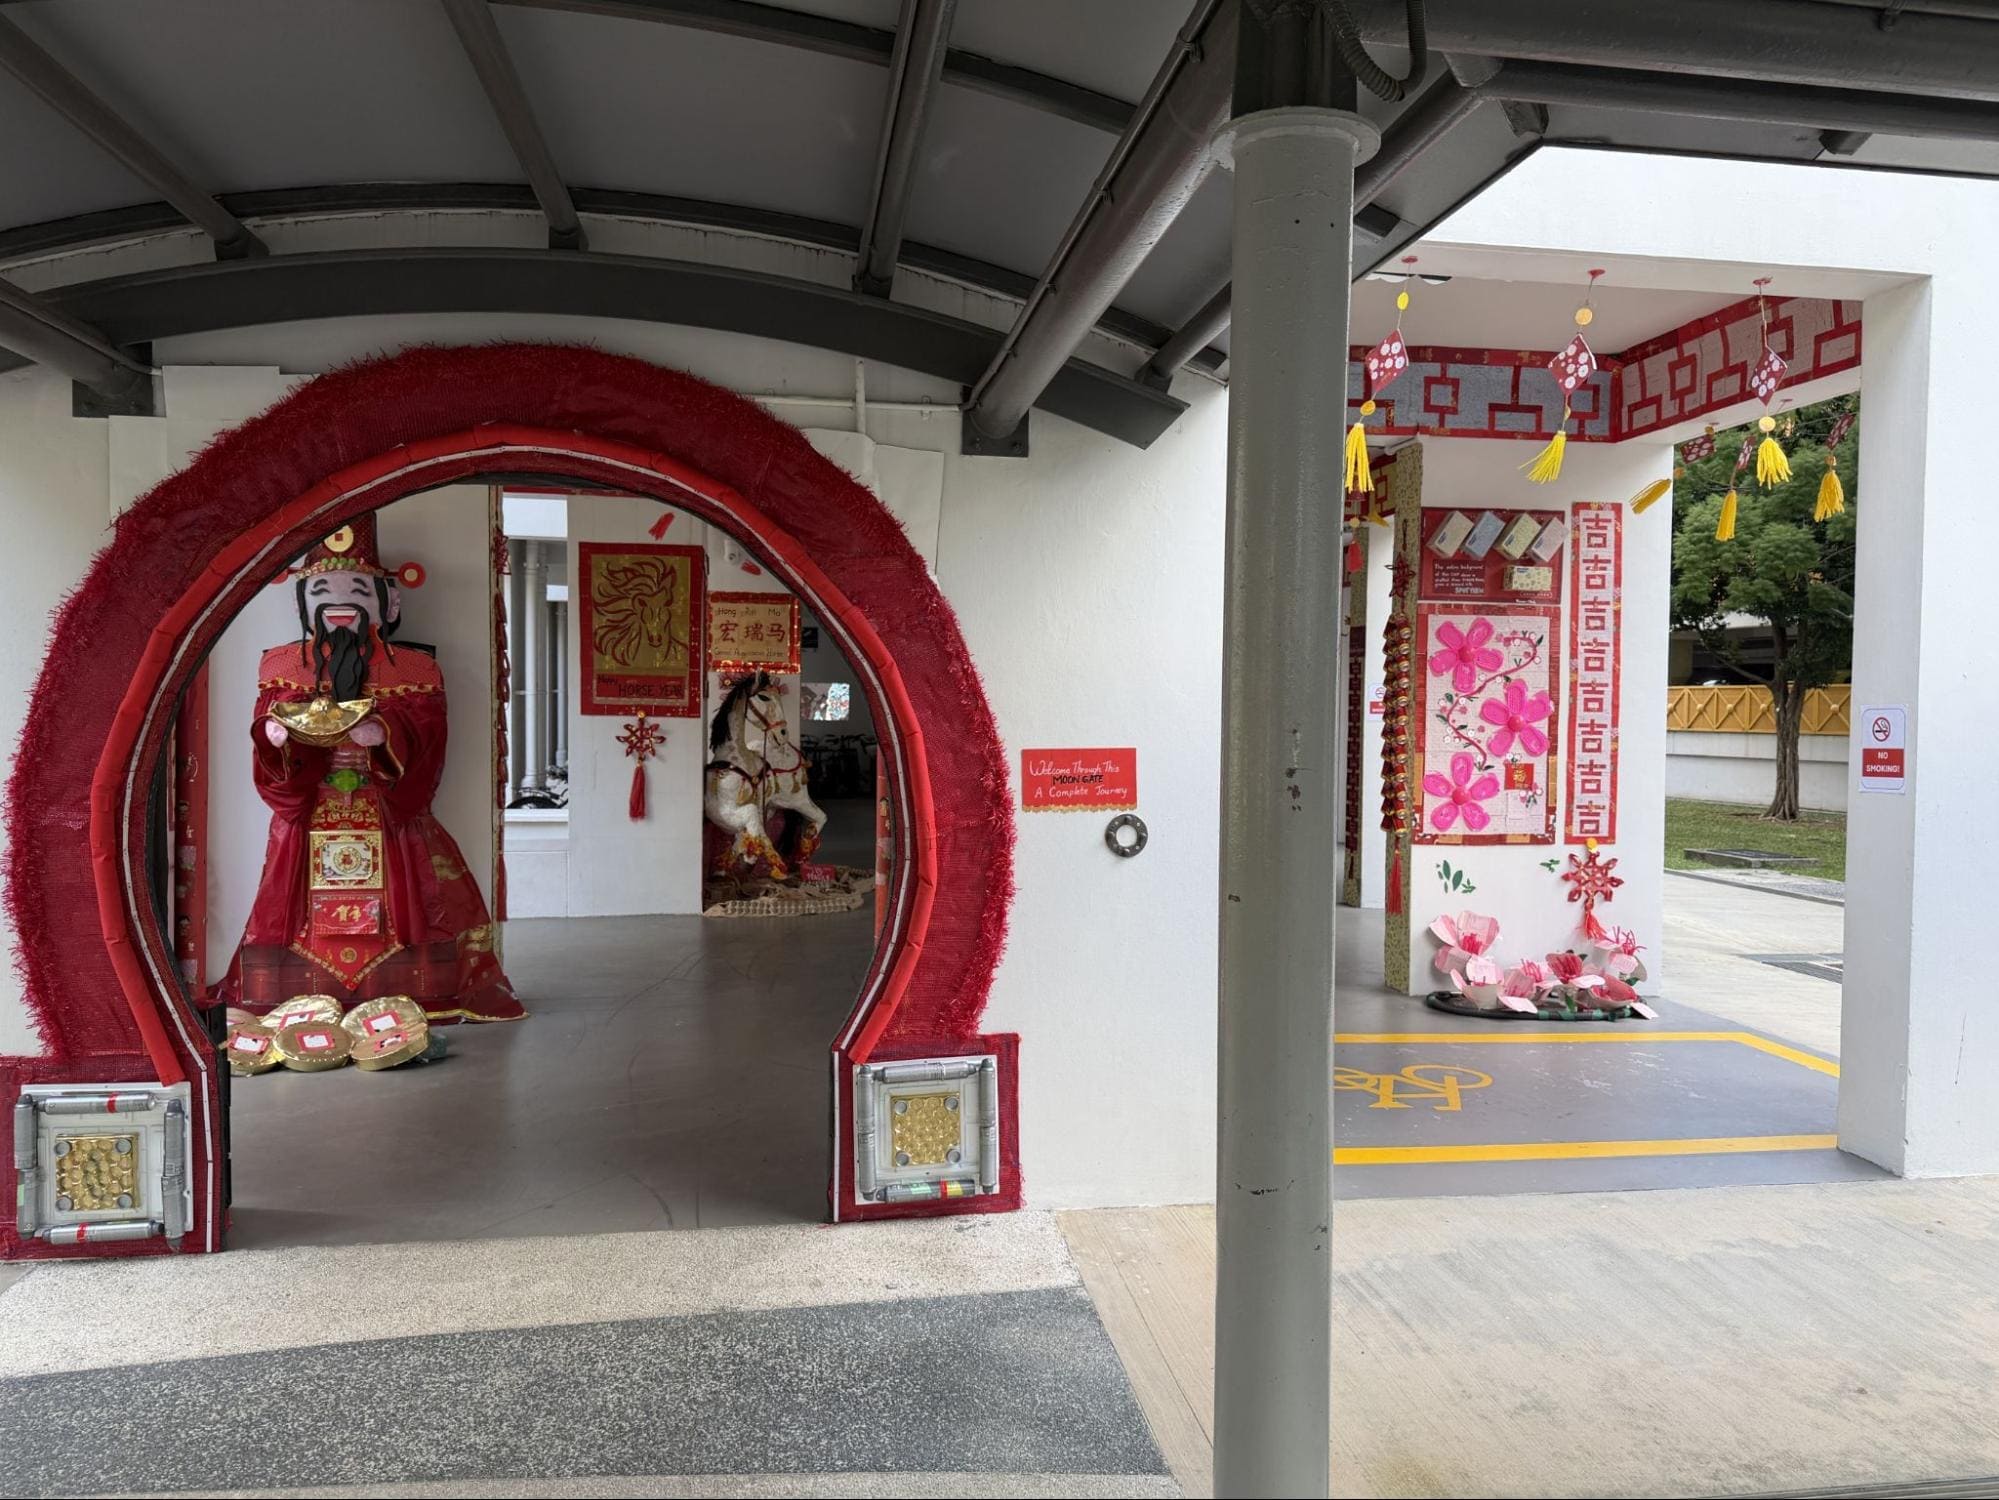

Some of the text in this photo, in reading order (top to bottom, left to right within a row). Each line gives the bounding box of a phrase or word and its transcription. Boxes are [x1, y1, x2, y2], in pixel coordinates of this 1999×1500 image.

[619, 683, 654, 697] HORSE
[1877, 751, 1888, 760] NO
[1029, 760, 1120, 776] Welcome Through This
[1052, 774, 1104, 785] MOON GATE
[1034, 785, 1128, 799] A Complete Journey
